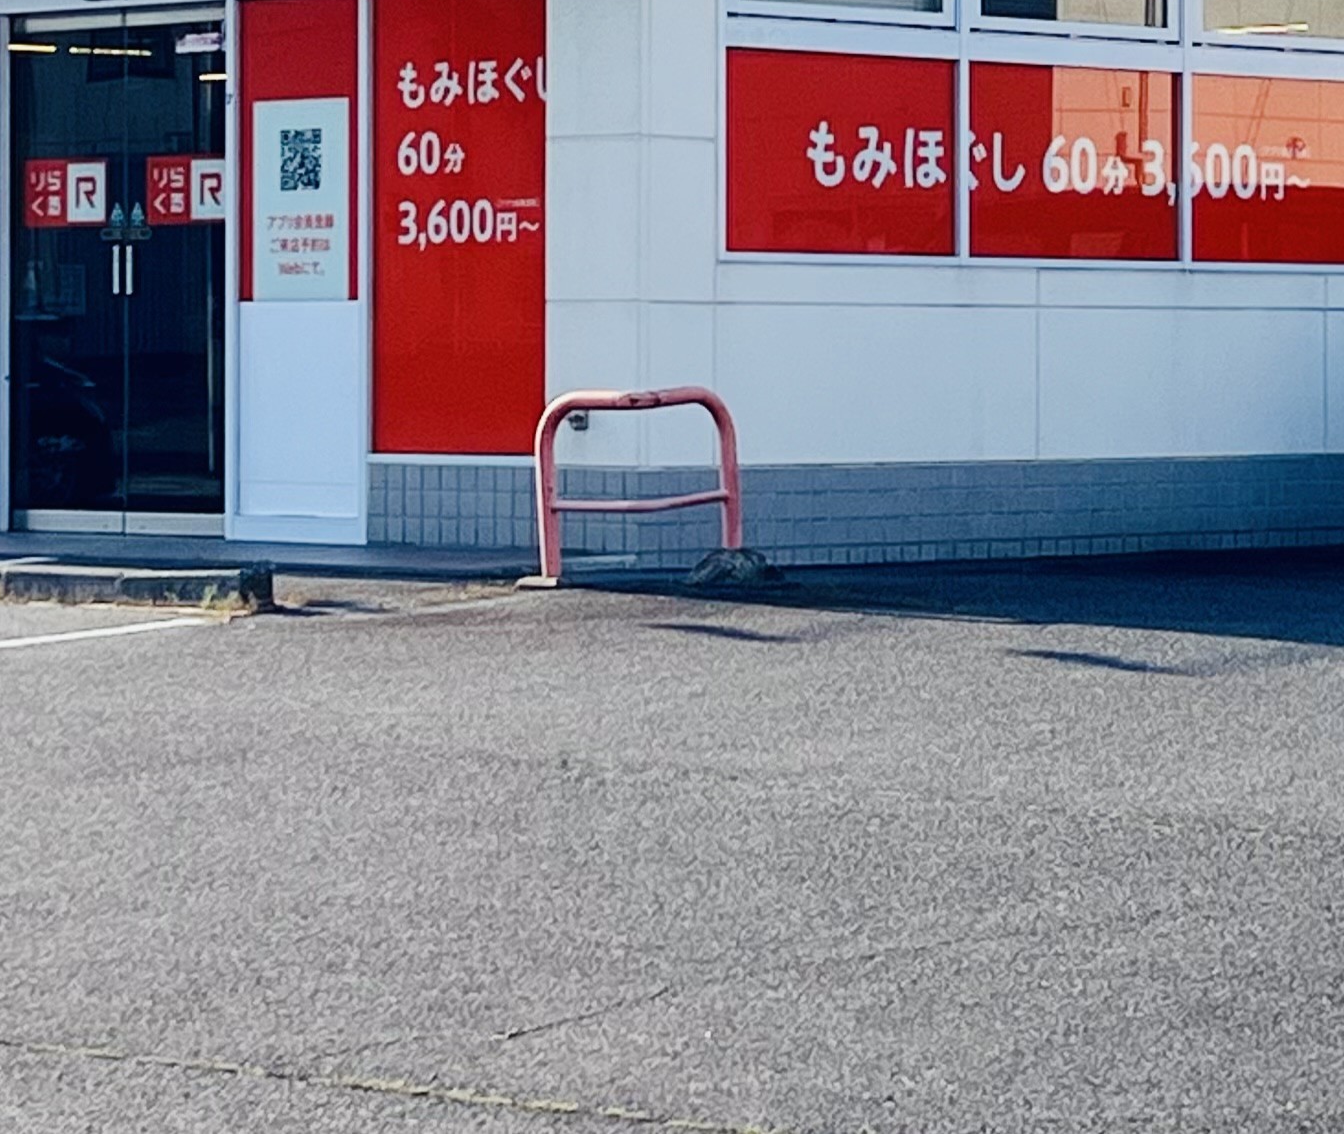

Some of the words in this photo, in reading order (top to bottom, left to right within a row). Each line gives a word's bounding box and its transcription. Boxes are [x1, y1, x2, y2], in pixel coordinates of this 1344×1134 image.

[398, 131, 465, 175] 60分
[1043, 136, 1129, 194] 60分
[75, 176, 97, 208] R
[199, 173, 222, 206] R
